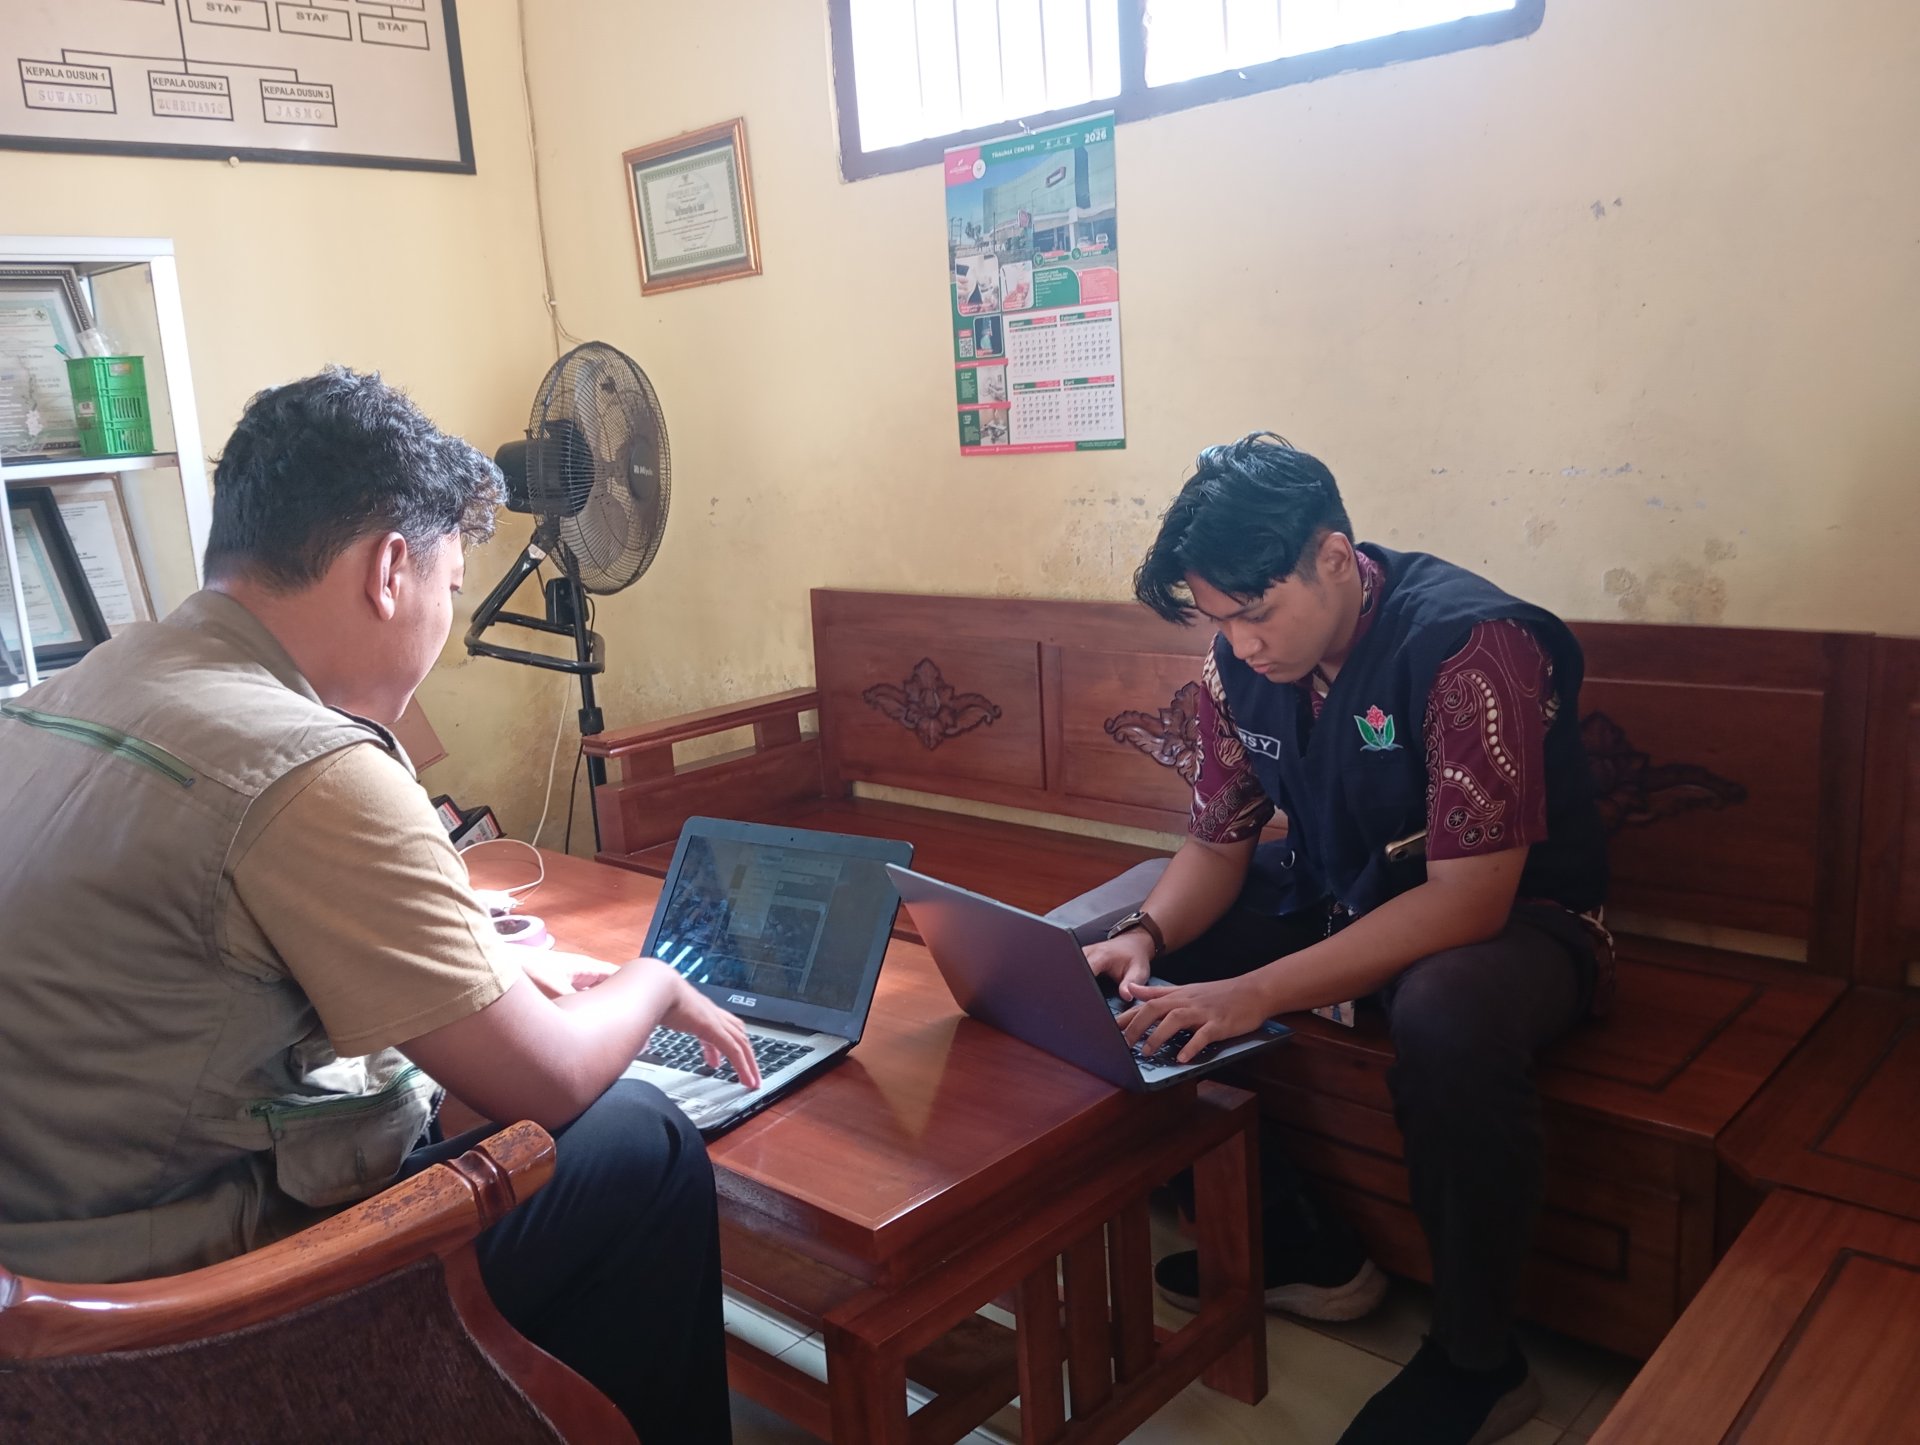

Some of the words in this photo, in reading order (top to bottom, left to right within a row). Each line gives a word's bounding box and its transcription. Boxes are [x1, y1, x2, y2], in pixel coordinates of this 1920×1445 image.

[206, 2, 242, 15] STAF
[296, 11, 329, 23] STAF
[377, 21, 408, 33] STAF
[25, 66, 64, 78] KEPALA
[65, 69, 99, 81] DUSUN
[101, 73, 106, 81] 1
[152, 77, 186, 88] KEPALA
[187, 80, 217, 90] DUSUN
[218, 82, 224, 91] 2
[39, 90, 98, 105] SUWANDI
[264, 86, 296, 96] KEPALA
[296, 88, 324, 98] DUSUN
[325, 91, 330, 99] 3
[1084, 130, 1107, 144] 2026
[727, 994, 757, 1007] ASUS
